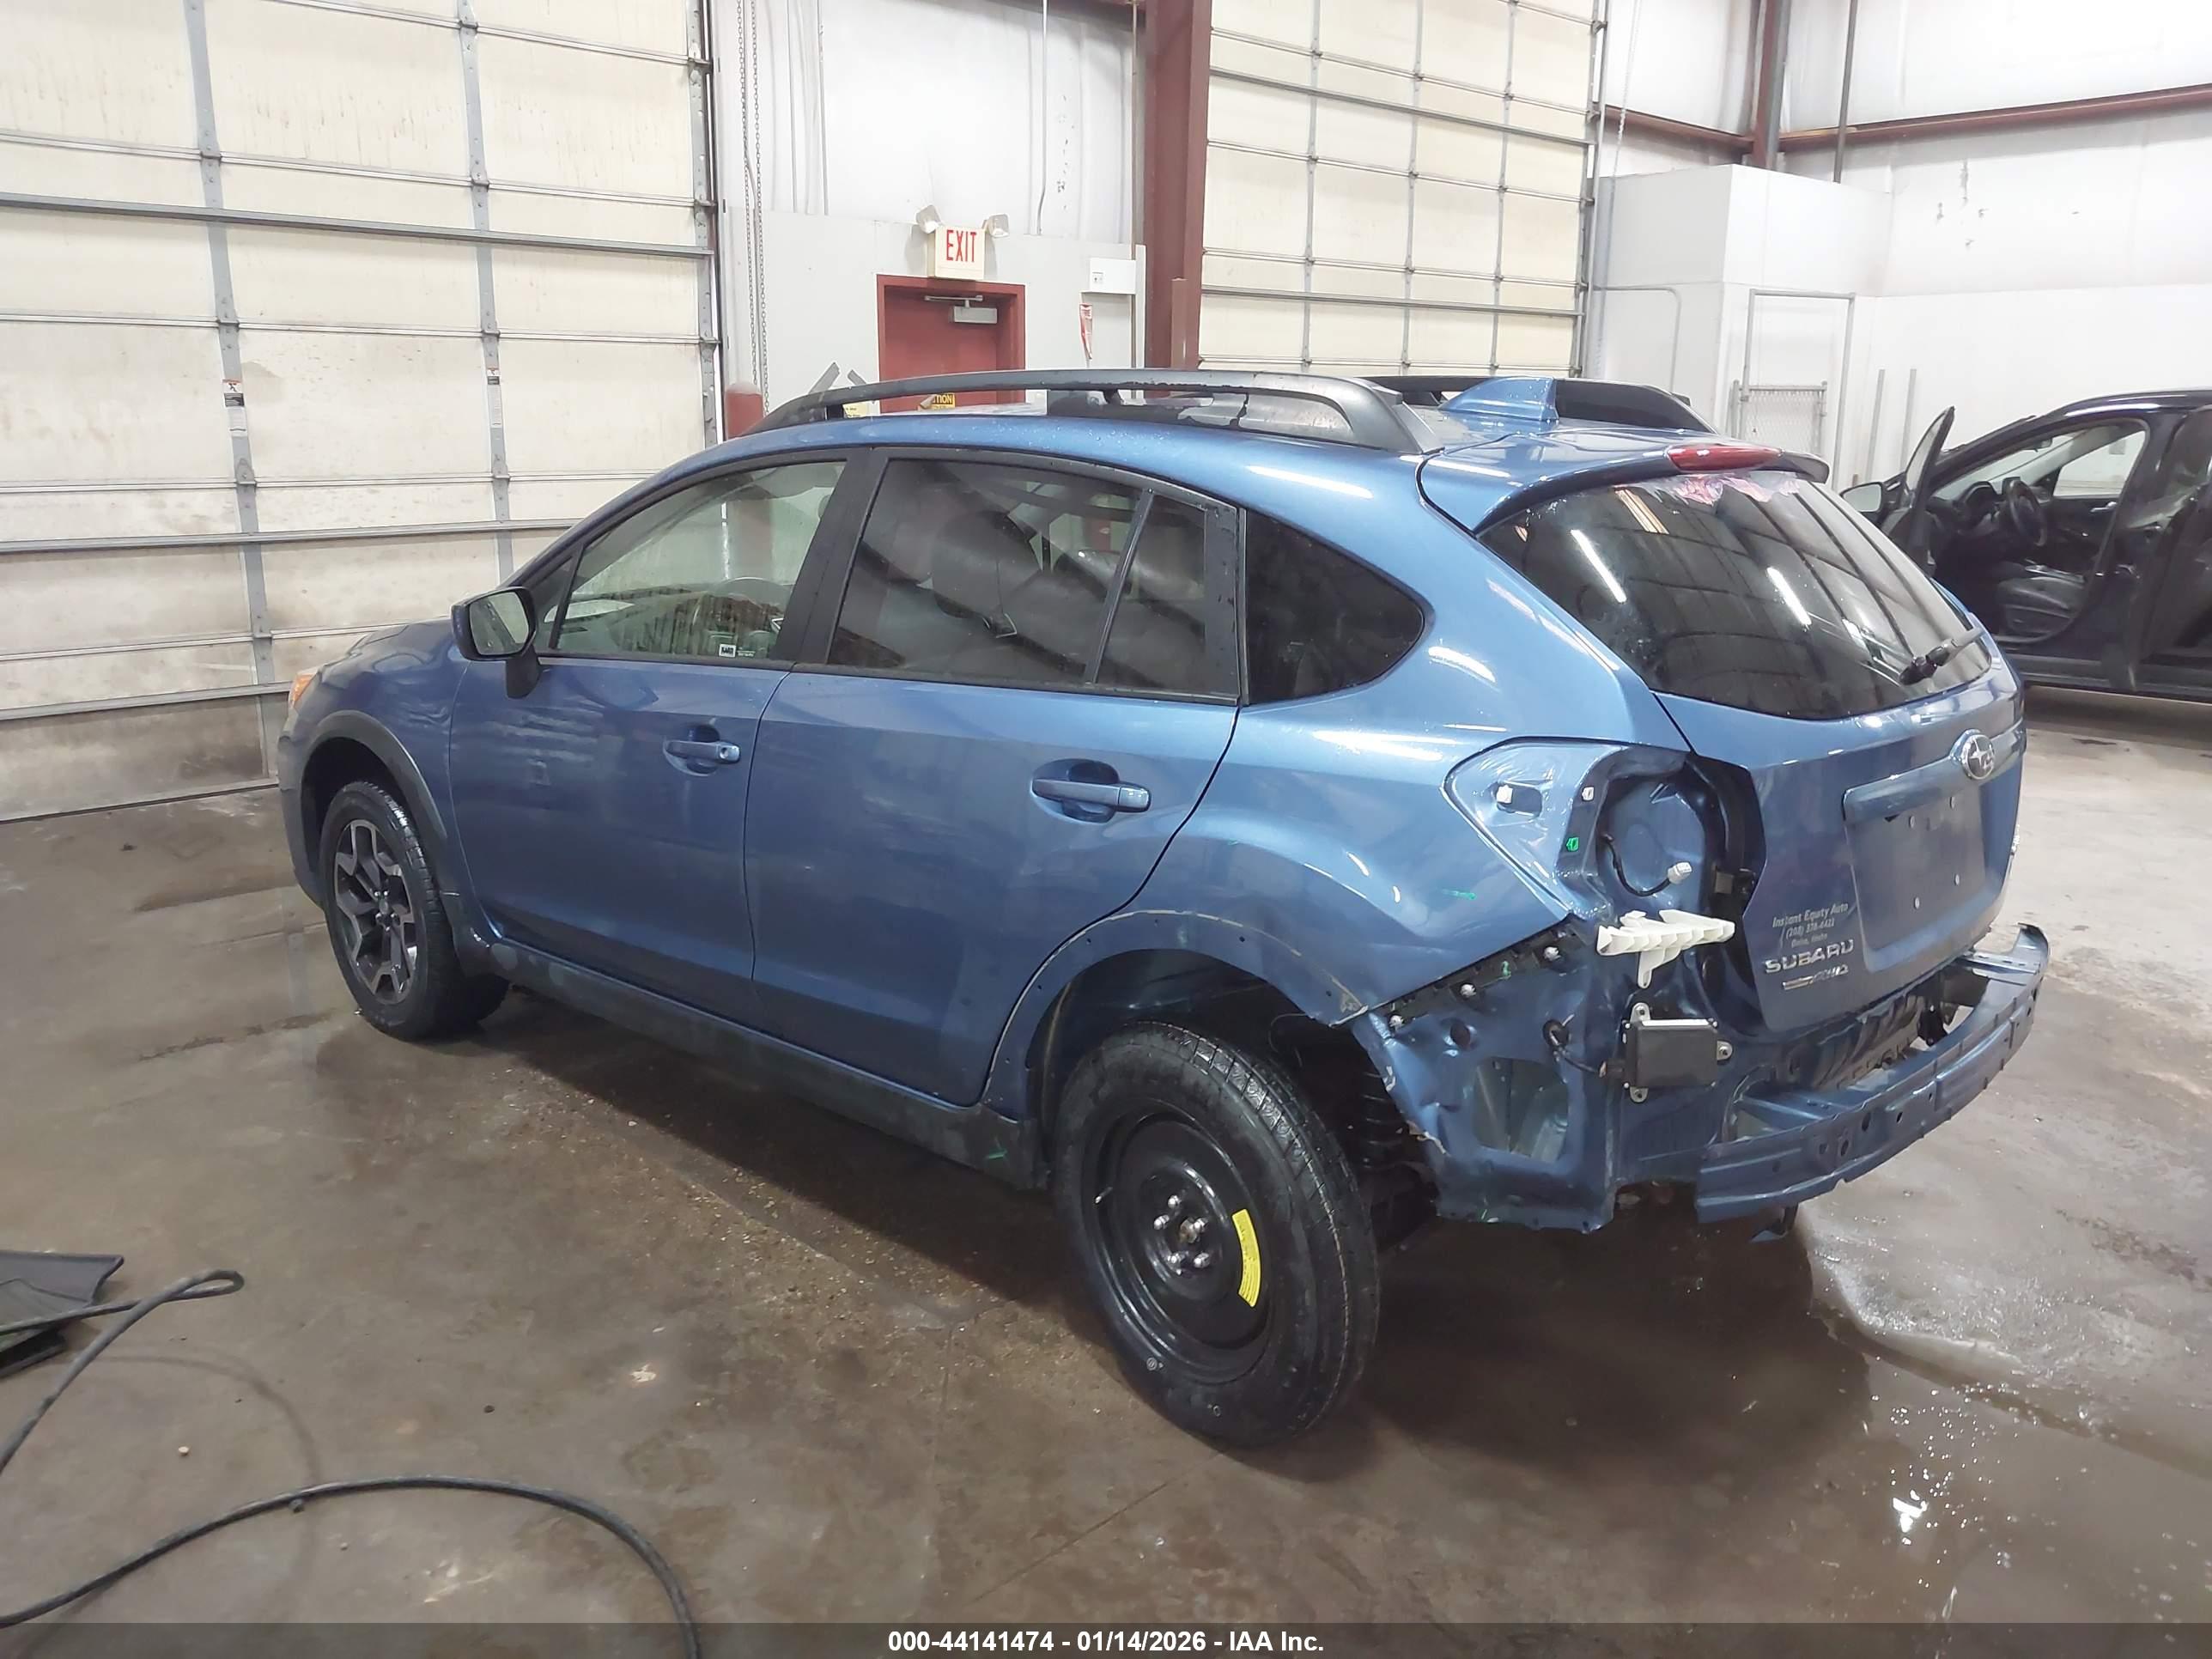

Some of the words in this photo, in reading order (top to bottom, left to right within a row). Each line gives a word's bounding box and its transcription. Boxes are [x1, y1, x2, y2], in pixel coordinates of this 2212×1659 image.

[946, 229, 977, 263] EXIT
[1830, 903, 1849, 915] Auto
[1765, 939, 1854, 974] SUBARU
